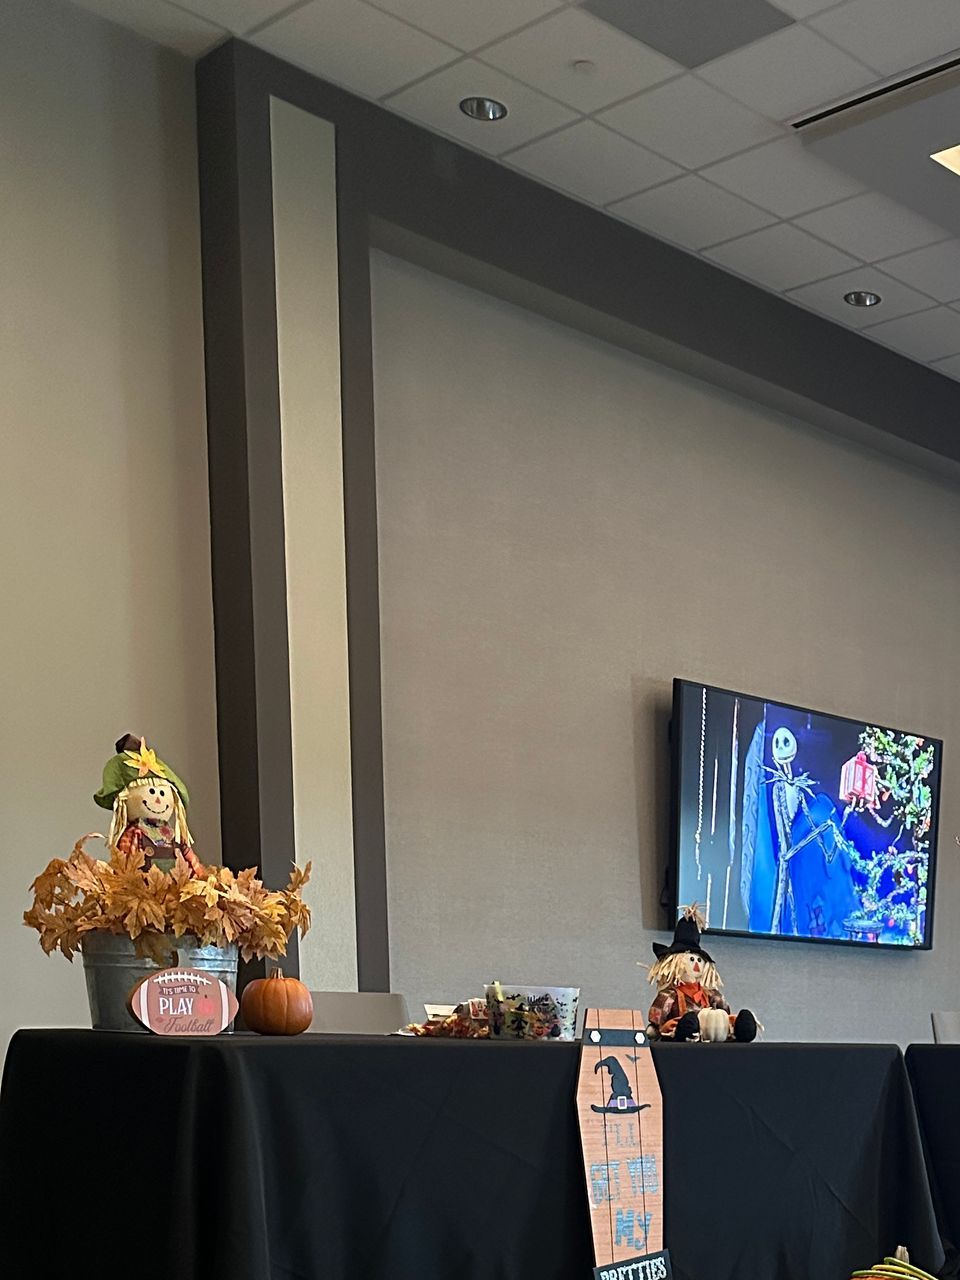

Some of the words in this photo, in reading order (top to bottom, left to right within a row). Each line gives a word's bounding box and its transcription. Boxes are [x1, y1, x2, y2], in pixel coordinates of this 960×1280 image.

[174, 986, 187, 994] TIME
[188, 985, 196, 993] TO
[159, 997, 194, 1015] PLAY
[164, 1016, 213, 1033] Football
[590, 1160, 620, 1204] GET
[626, 1154, 659, 1196] YOU
[614, 1208, 653, 1250] MY
